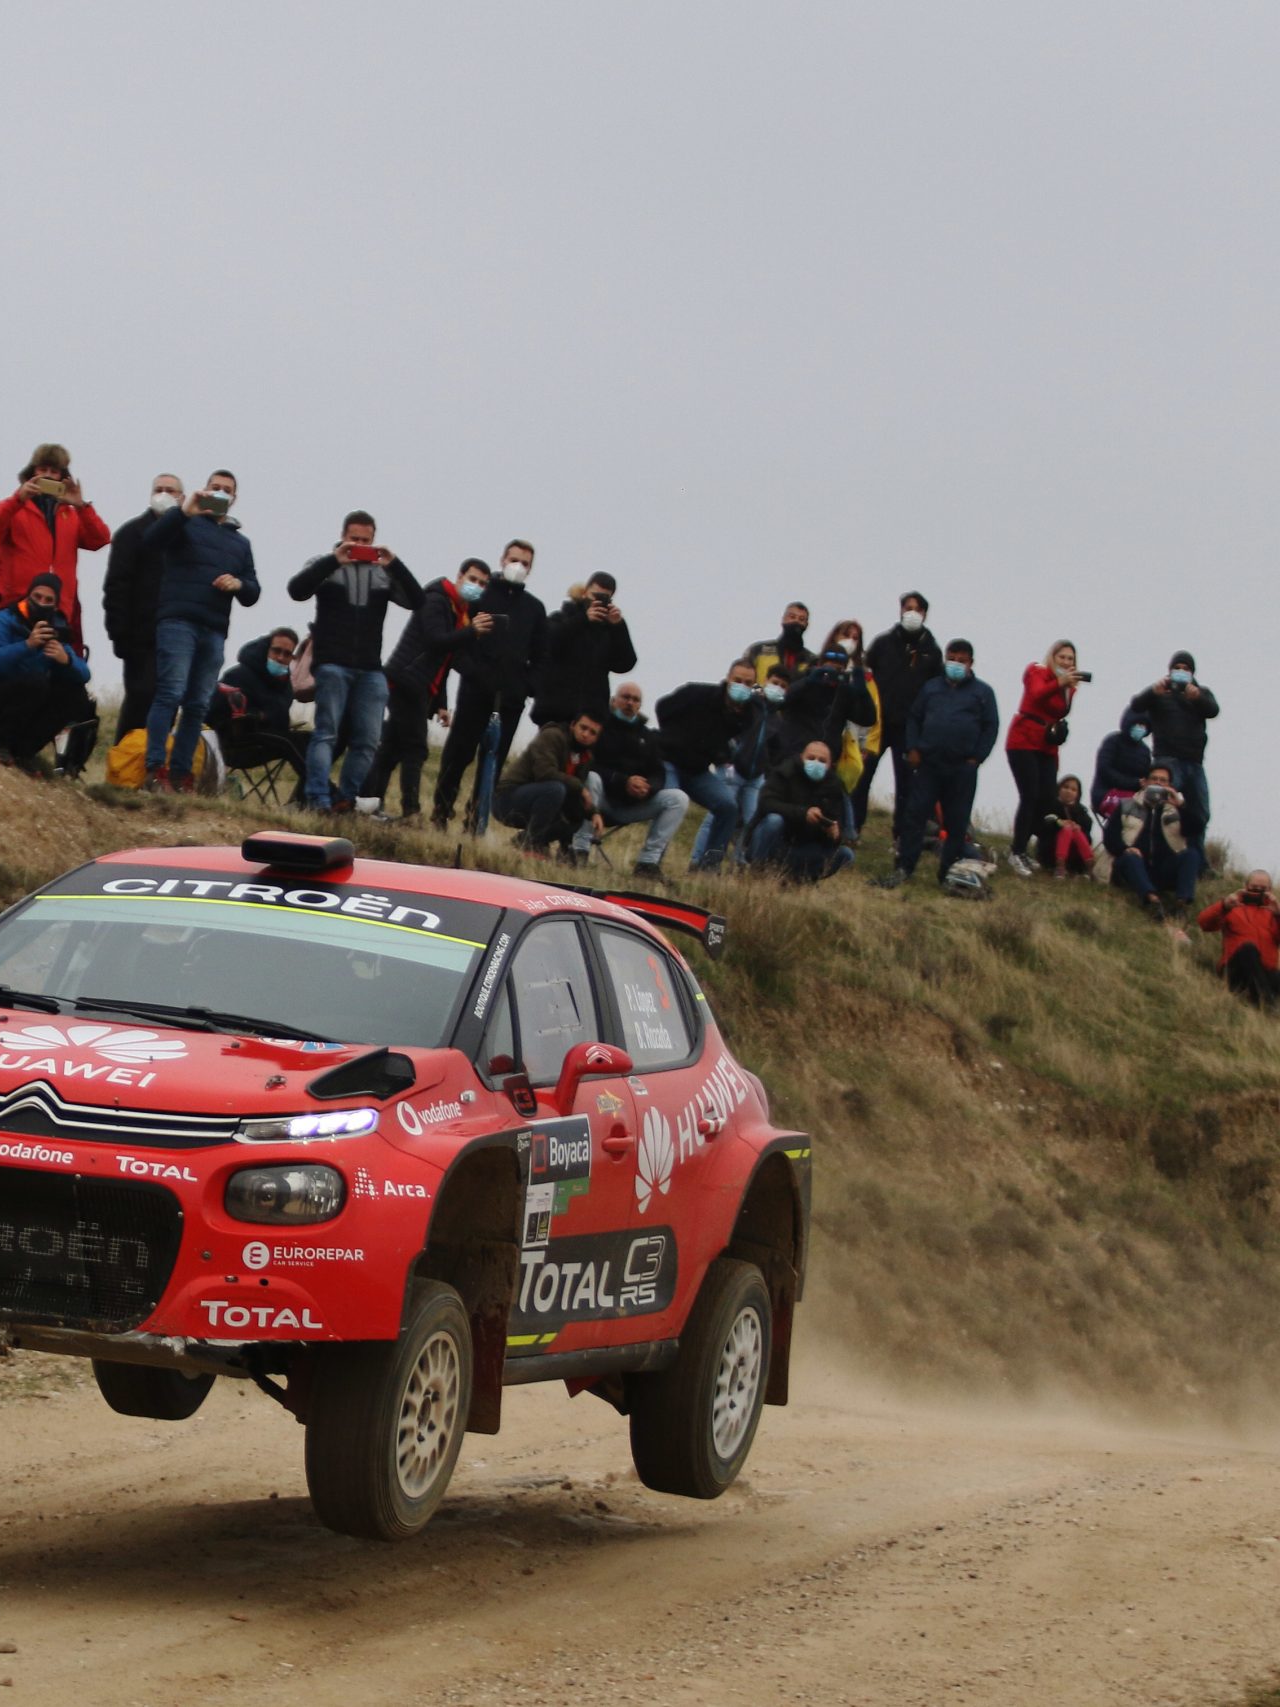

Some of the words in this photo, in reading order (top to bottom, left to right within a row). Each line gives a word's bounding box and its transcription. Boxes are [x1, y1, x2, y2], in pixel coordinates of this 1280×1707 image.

[418, 1100, 462, 1124] vodafone
[677, 1052, 749, 1164] HUAWEI
[116, 1155, 198, 1182] TOTAL
[273, 1247, 364, 1261] EUROREPAR
[624, 1235, 666, 1283] C3
[519, 1251, 614, 1313] TOTAL
[200, 1300, 323, 1328] TOTAL
